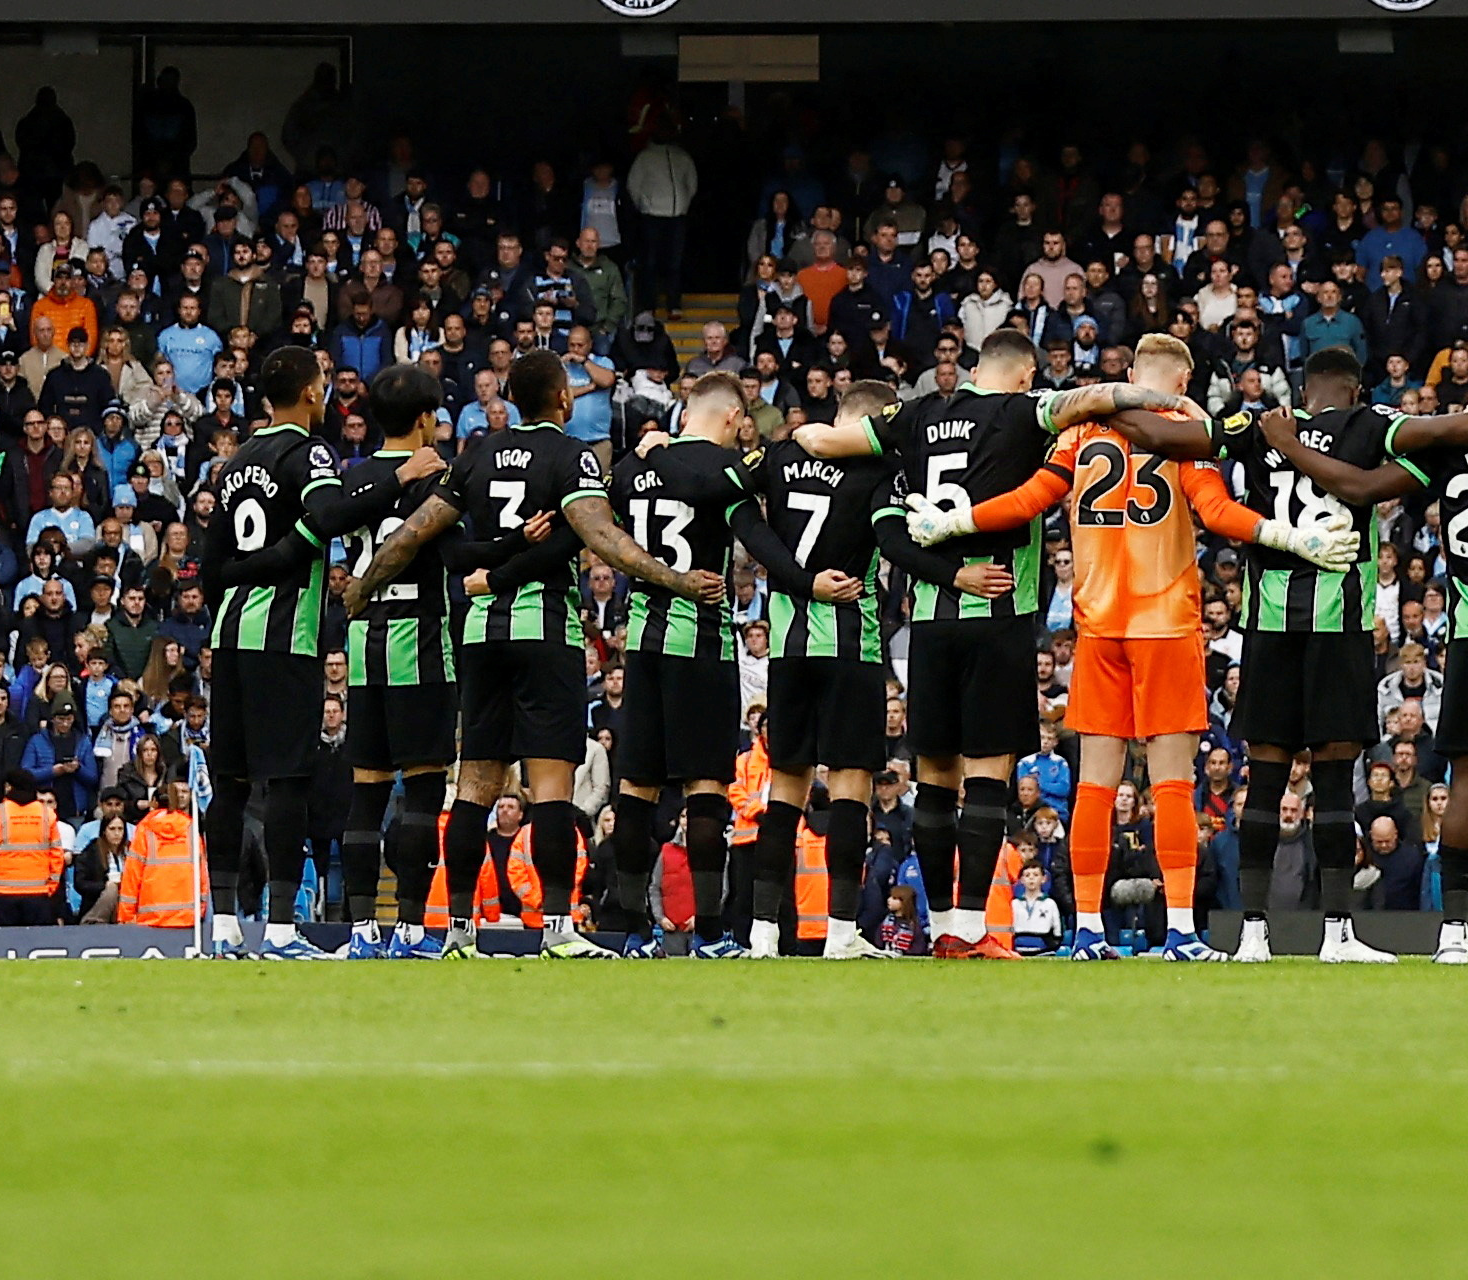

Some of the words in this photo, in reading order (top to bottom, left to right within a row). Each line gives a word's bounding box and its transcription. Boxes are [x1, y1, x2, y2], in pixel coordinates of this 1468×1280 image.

[495, 448, 532, 470] IGOR
[926, 419, 976, 444] DUNK
[244, 465, 279, 499] PEDRO
[783, 459, 845, 489] MARCH
[926, 452, 972, 513] 5
[1077, 439, 1174, 528] 23
[1269, 470, 1353, 532] 18
[489, 481, 526, 541] 3
[629, 498, 695, 582] 13
[787, 491, 831, 569] 7
